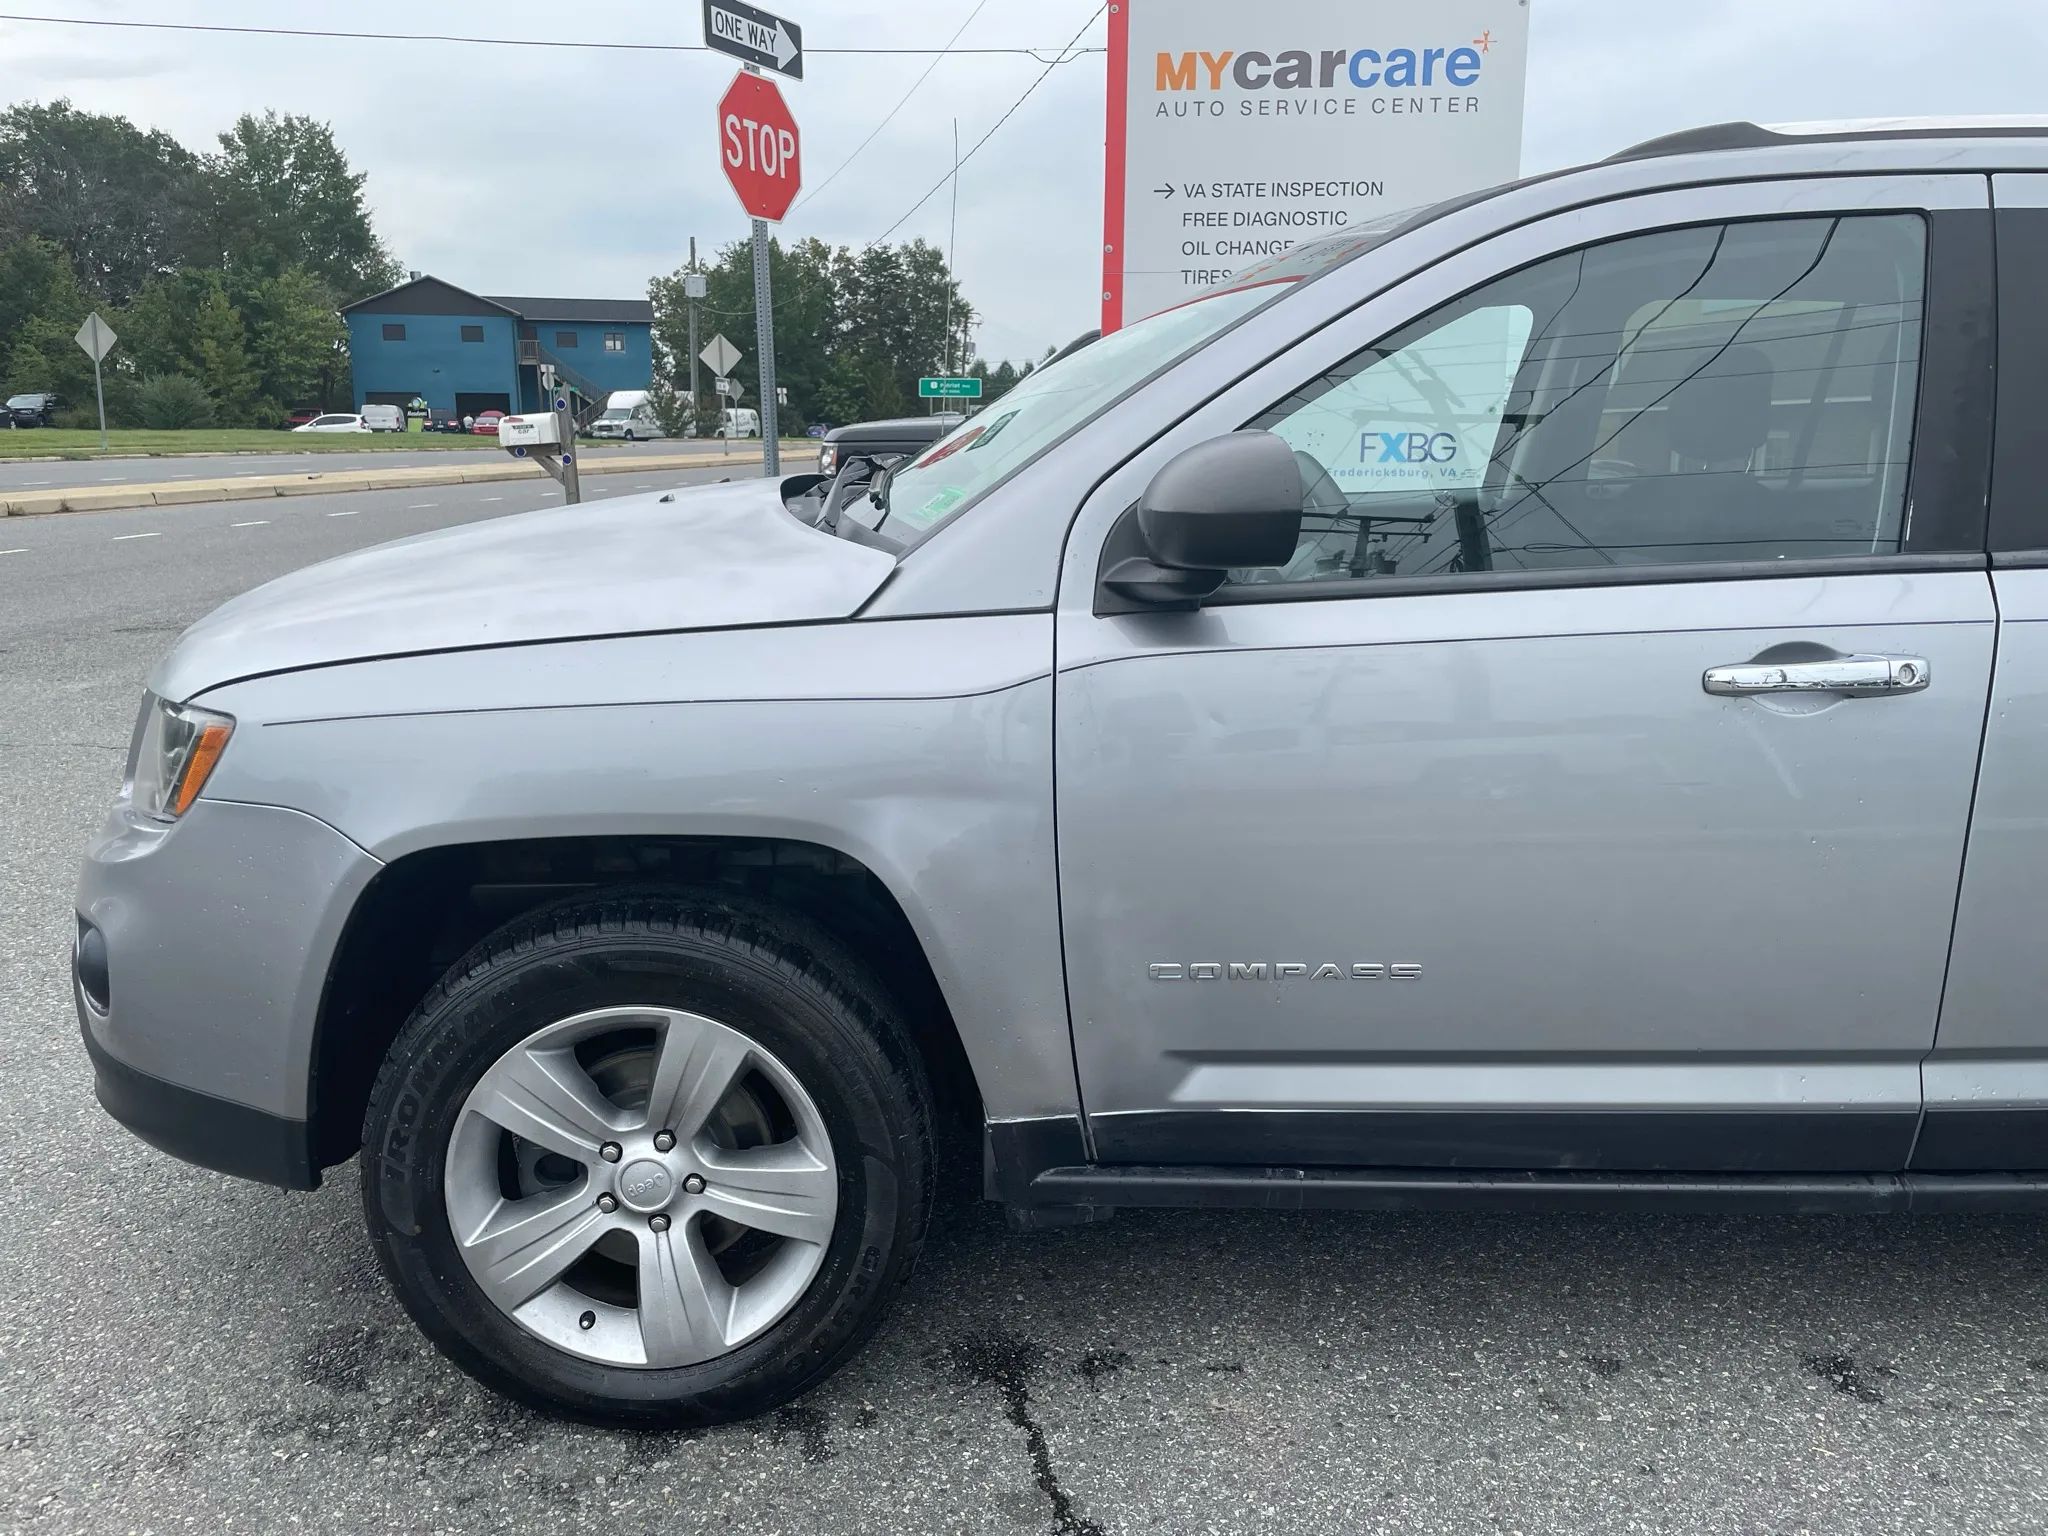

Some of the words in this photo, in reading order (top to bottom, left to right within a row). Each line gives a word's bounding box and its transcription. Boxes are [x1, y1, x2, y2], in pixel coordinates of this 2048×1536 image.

[715, 11, 743, 41] ONE
[747, 22, 776, 53] WAY
[1156, 48, 1481, 91] MYcarcare
[1156, 101, 1225, 117] AUTO
[1241, 99, 1356, 116] SERVICE
[1372, 97, 1479, 113] CENTER
[725, 114, 796, 179] STOP
[1184, 183, 1206, 198] VA
[1212, 183, 1267, 198] STATE
[1271, 181, 1384, 197] INSPECTION
[1183, 212, 1228, 227] FREE
[1233, 211, 1348, 226] DIAGNOSTIC
[1182, 241, 1210, 255] OIL
[1360, 432, 1457, 463] FXBG
[1440, 467, 1456, 477] VA
[1148, 962, 1423, 980] COMPASS
[628, 1172, 664, 1197] Jeep
